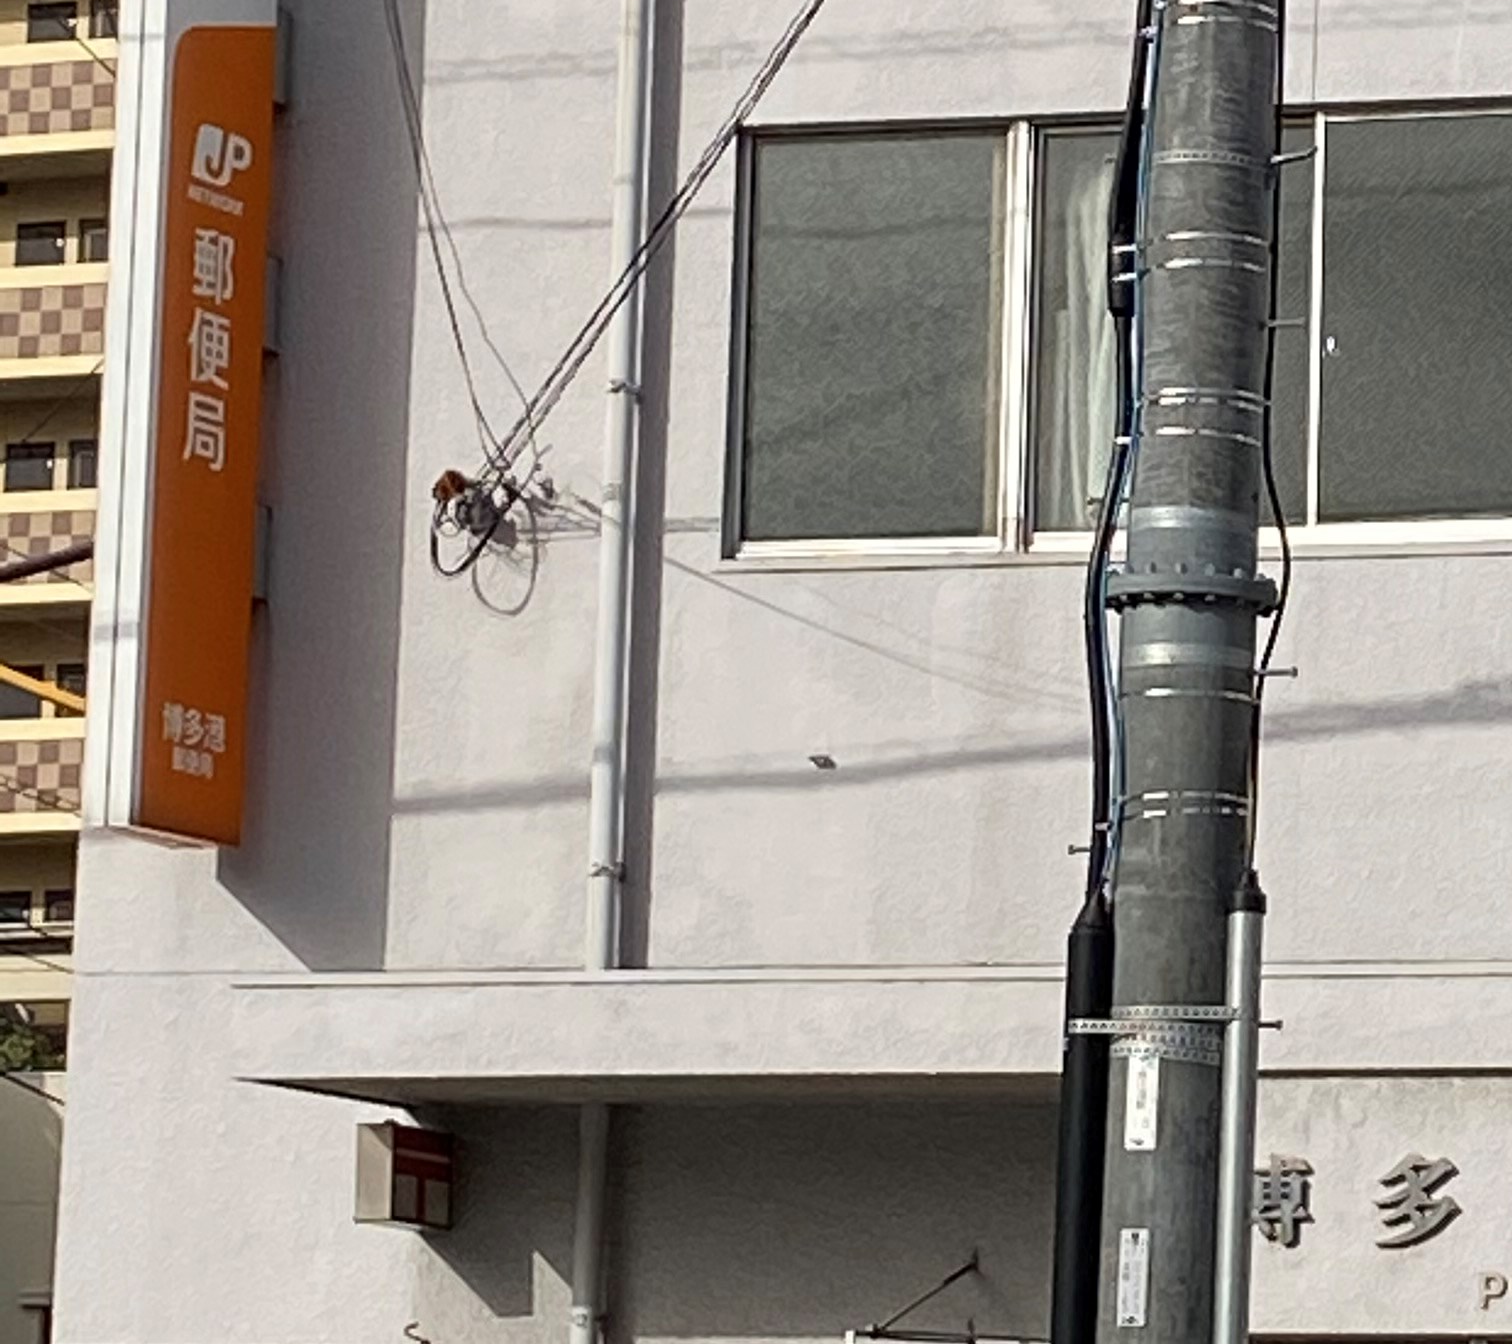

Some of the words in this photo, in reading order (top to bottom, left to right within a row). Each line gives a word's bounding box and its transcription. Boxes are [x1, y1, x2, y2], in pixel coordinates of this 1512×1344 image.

[191, 123, 252, 187] JP
[184, 227, 235, 472] 郵便局
[162, 702, 227, 753] 博多港
